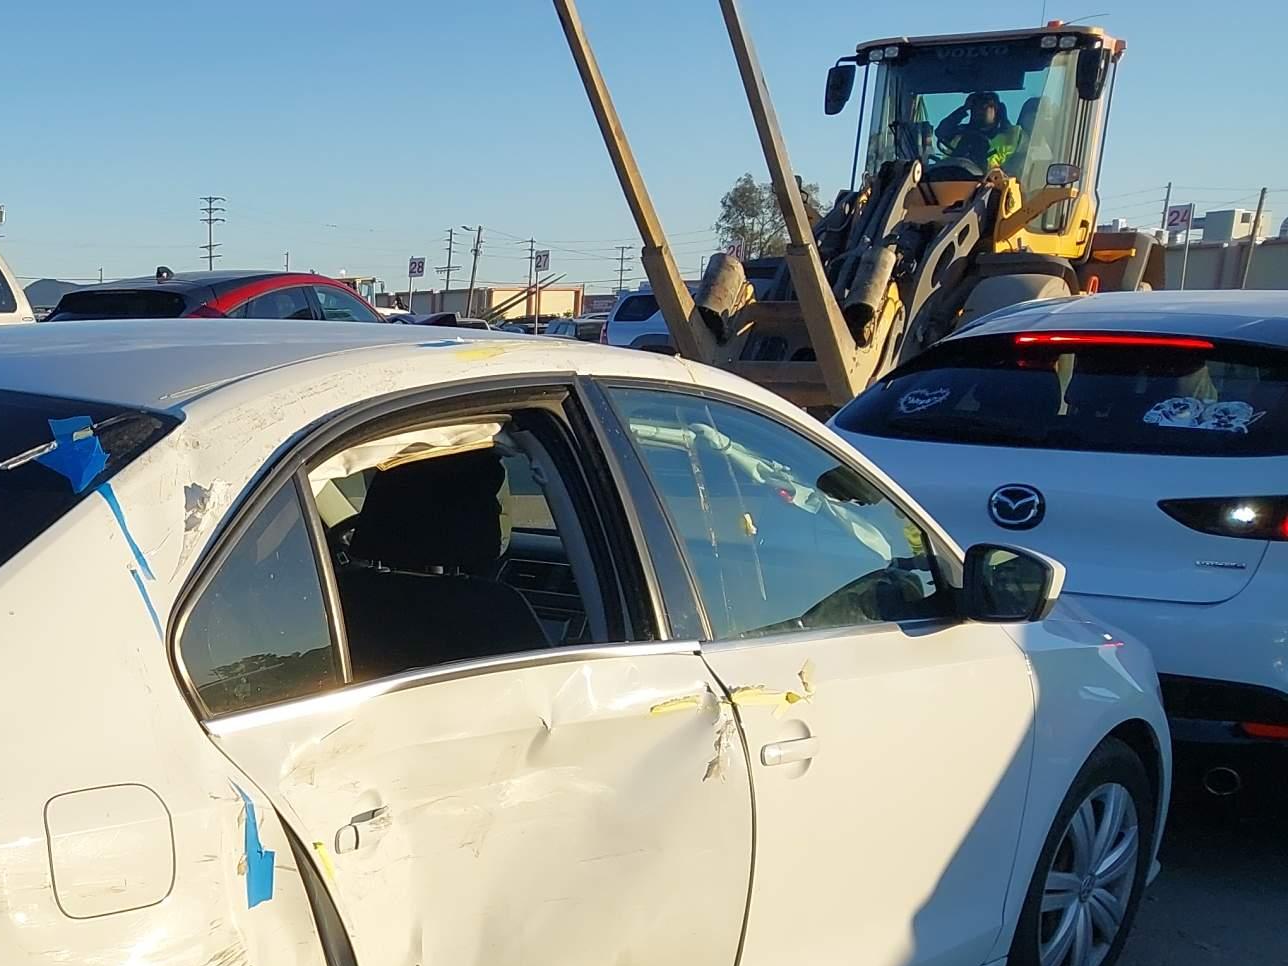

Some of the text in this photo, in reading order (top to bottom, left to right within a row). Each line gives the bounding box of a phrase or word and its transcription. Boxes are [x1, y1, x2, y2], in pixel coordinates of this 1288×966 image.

[935, 46, 1009, 60] VOLVO
[1168, 209, 1188, 227] 24
[411, 261, 424, 274] 28
[536, 254, 549, 268] 27
